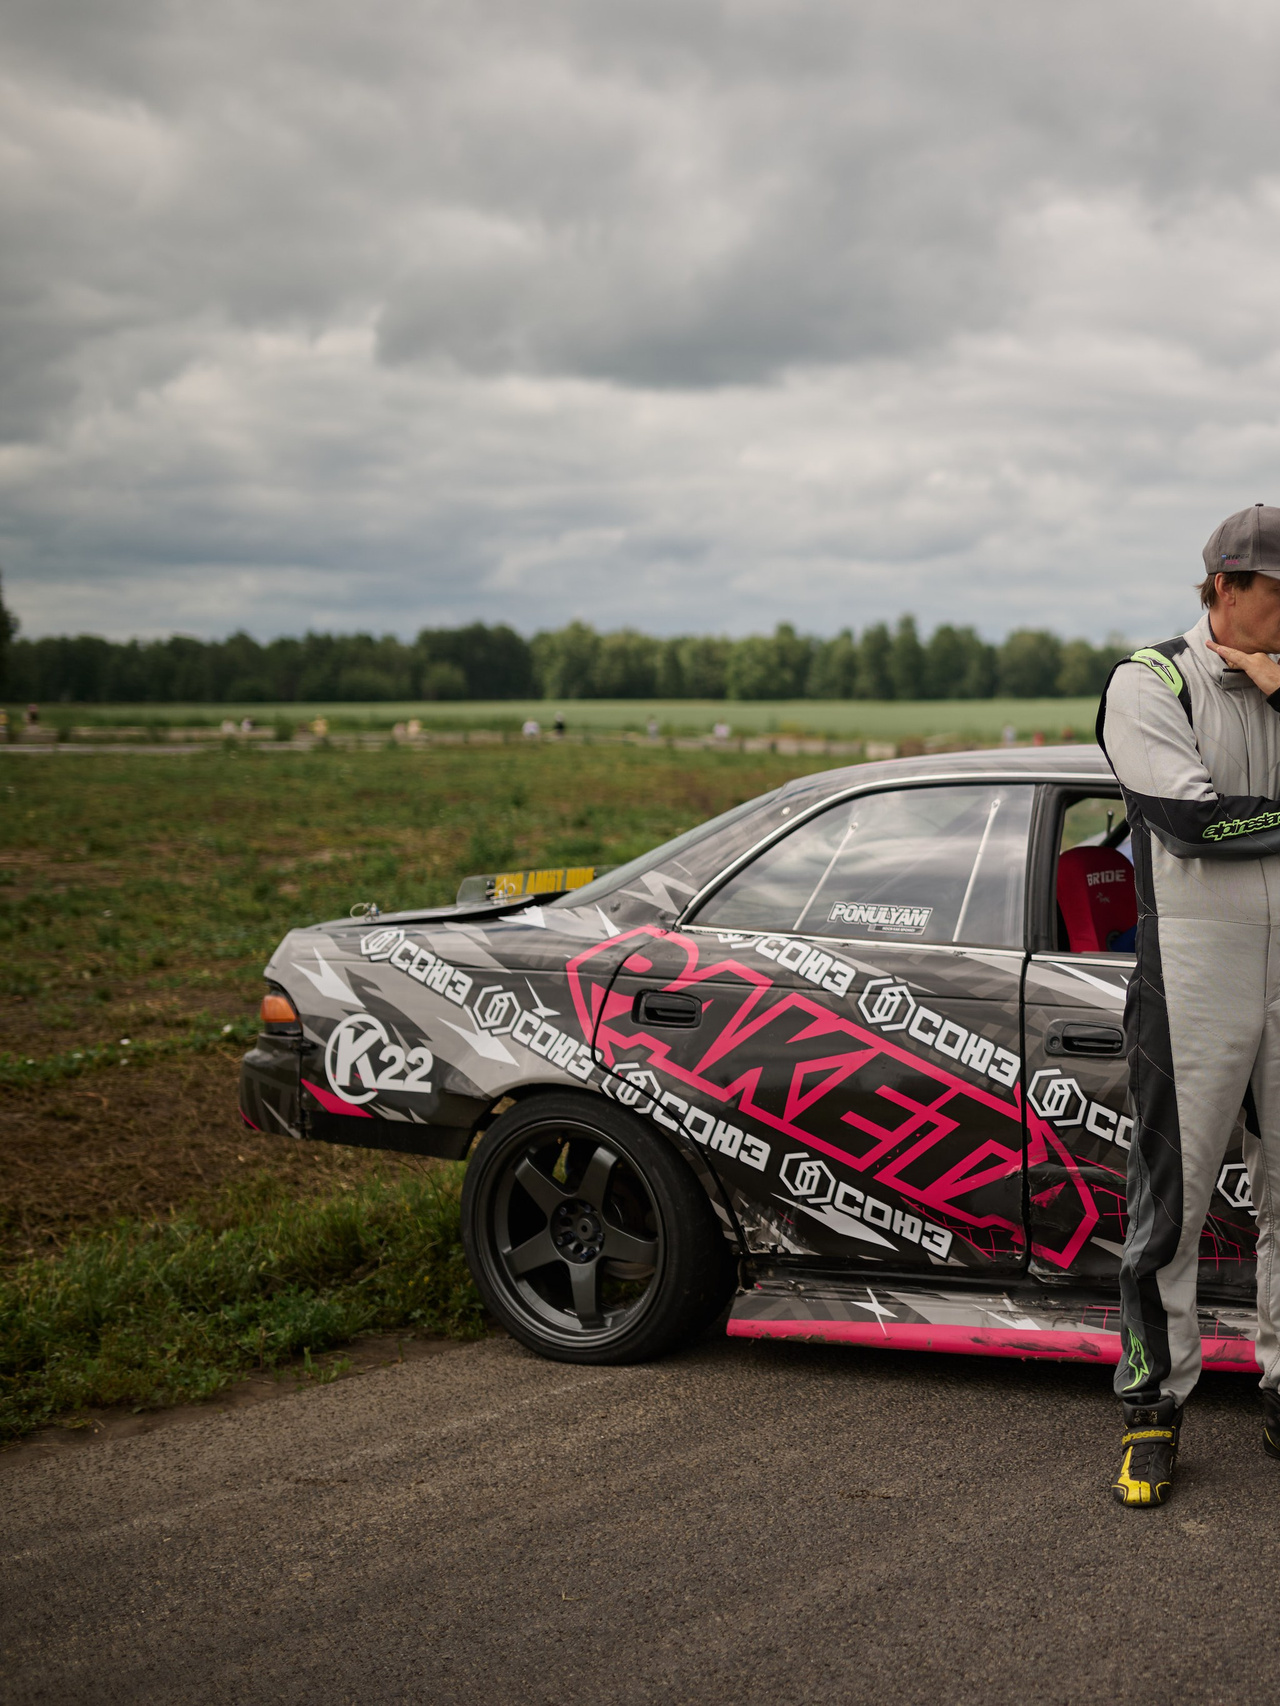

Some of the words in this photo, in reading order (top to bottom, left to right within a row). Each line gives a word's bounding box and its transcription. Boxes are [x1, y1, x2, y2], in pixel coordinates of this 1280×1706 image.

[1086, 869, 1127, 887] BRIDE
[829, 903, 931, 928] PONULYAM
[395, 938, 474, 1007] СОЮЗ
[754, 936, 856, 998] СОЮЗ
[511, 1017, 606, 1083] СОЮЗ
[908, 1008, 1022, 1089] СОЮЗ
[656, 1105, 772, 1173] СОЮЗ
[1085, 1101, 1134, 1151] СО
[832, 1185, 954, 1260] СОЮЗ
[1121, 1429, 1174, 1446] pinestars
